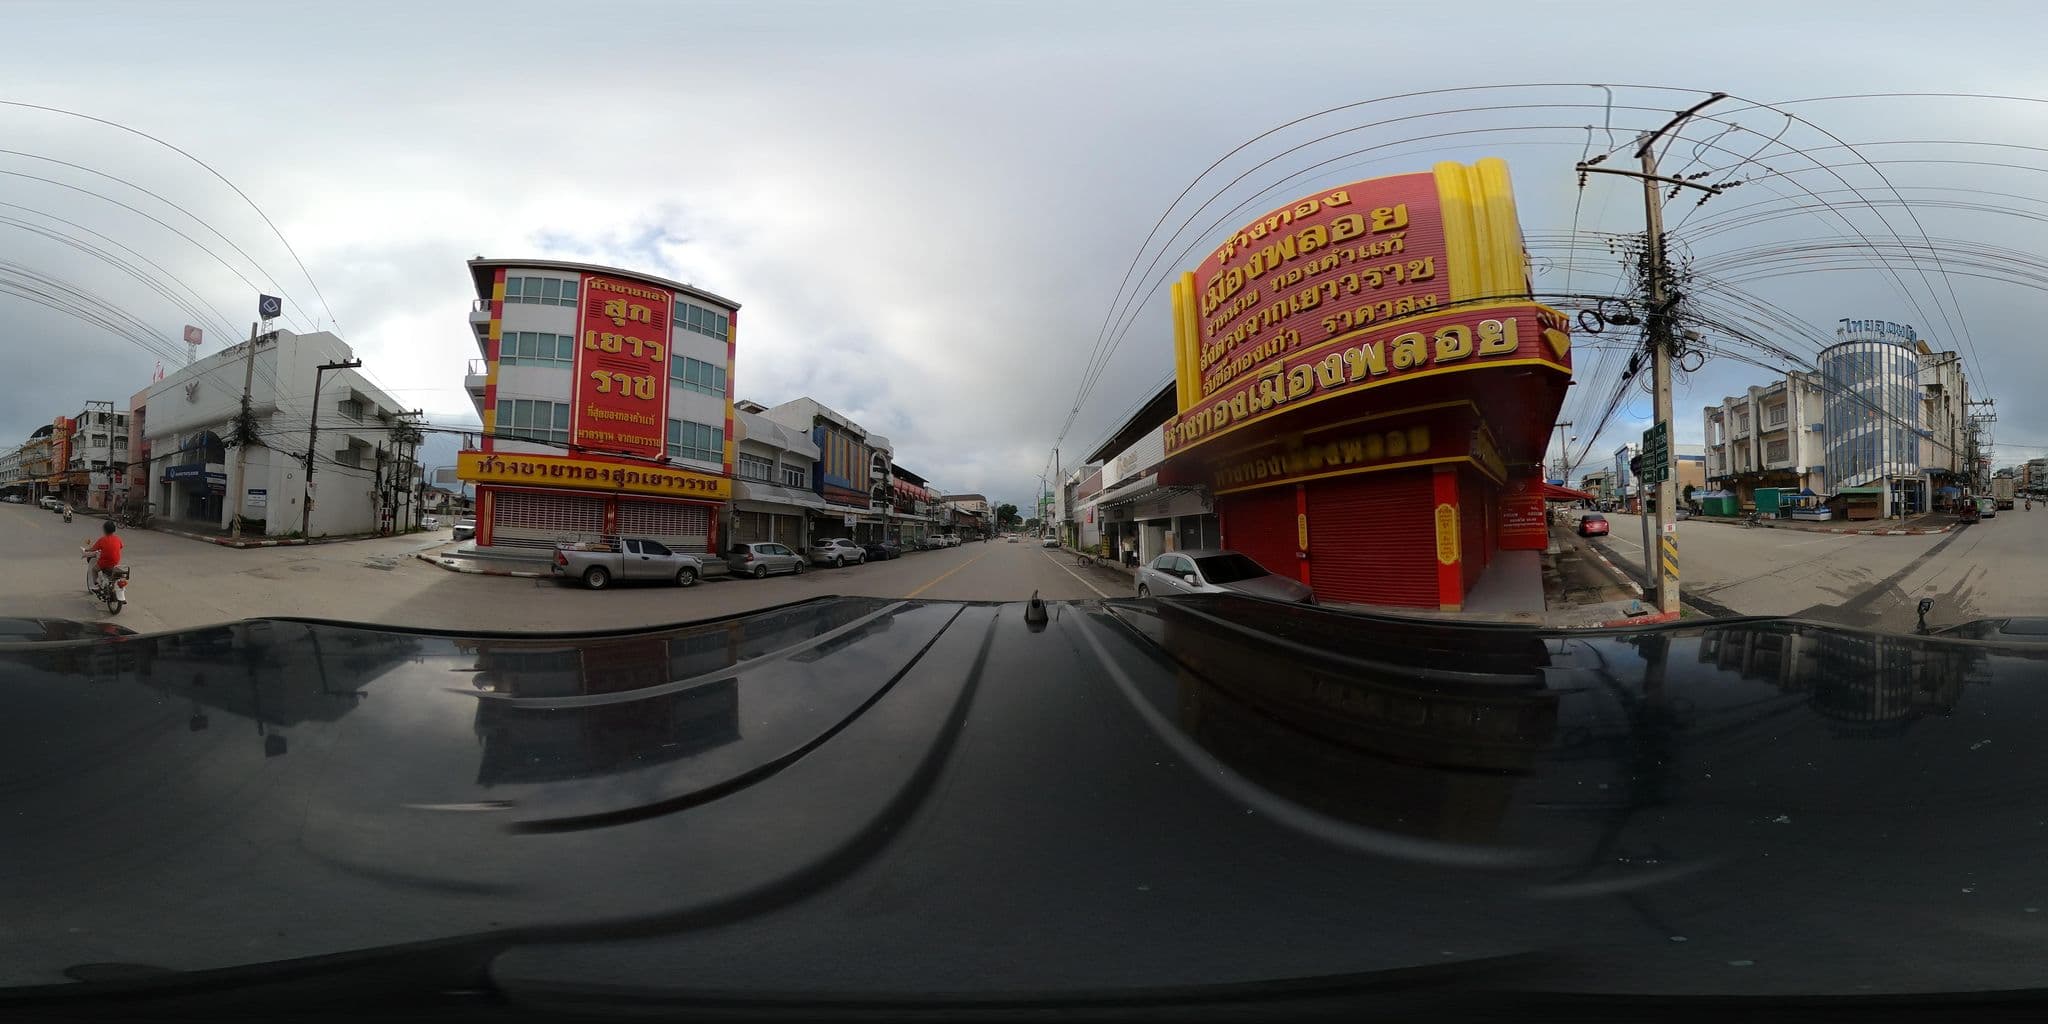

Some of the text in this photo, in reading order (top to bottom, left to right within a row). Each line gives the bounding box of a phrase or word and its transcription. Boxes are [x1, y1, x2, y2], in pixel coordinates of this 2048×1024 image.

[1217, 190, 1352, 267] ห้างทอง
[1201, 203, 1410, 319] เมืองพลอย
[1270, 232, 1407, 292] ทองคำแท้
[590, 279, 667, 302] ห้างขายทอง
[603, 299, 652, 327] สุก
[1200, 256, 1436, 372] สั่งตรงจากเยาวราช
[1320, 293, 1440, 334] ราคาสง
[585, 330, 665, 362] เยาว
[590, 369, 656, 400] ราช
[1164, 317, 1520, 451] ห้างทองเมืองพลอย
[477, 455, 719, 491] ห้างขายทองสุกเยาวราช
